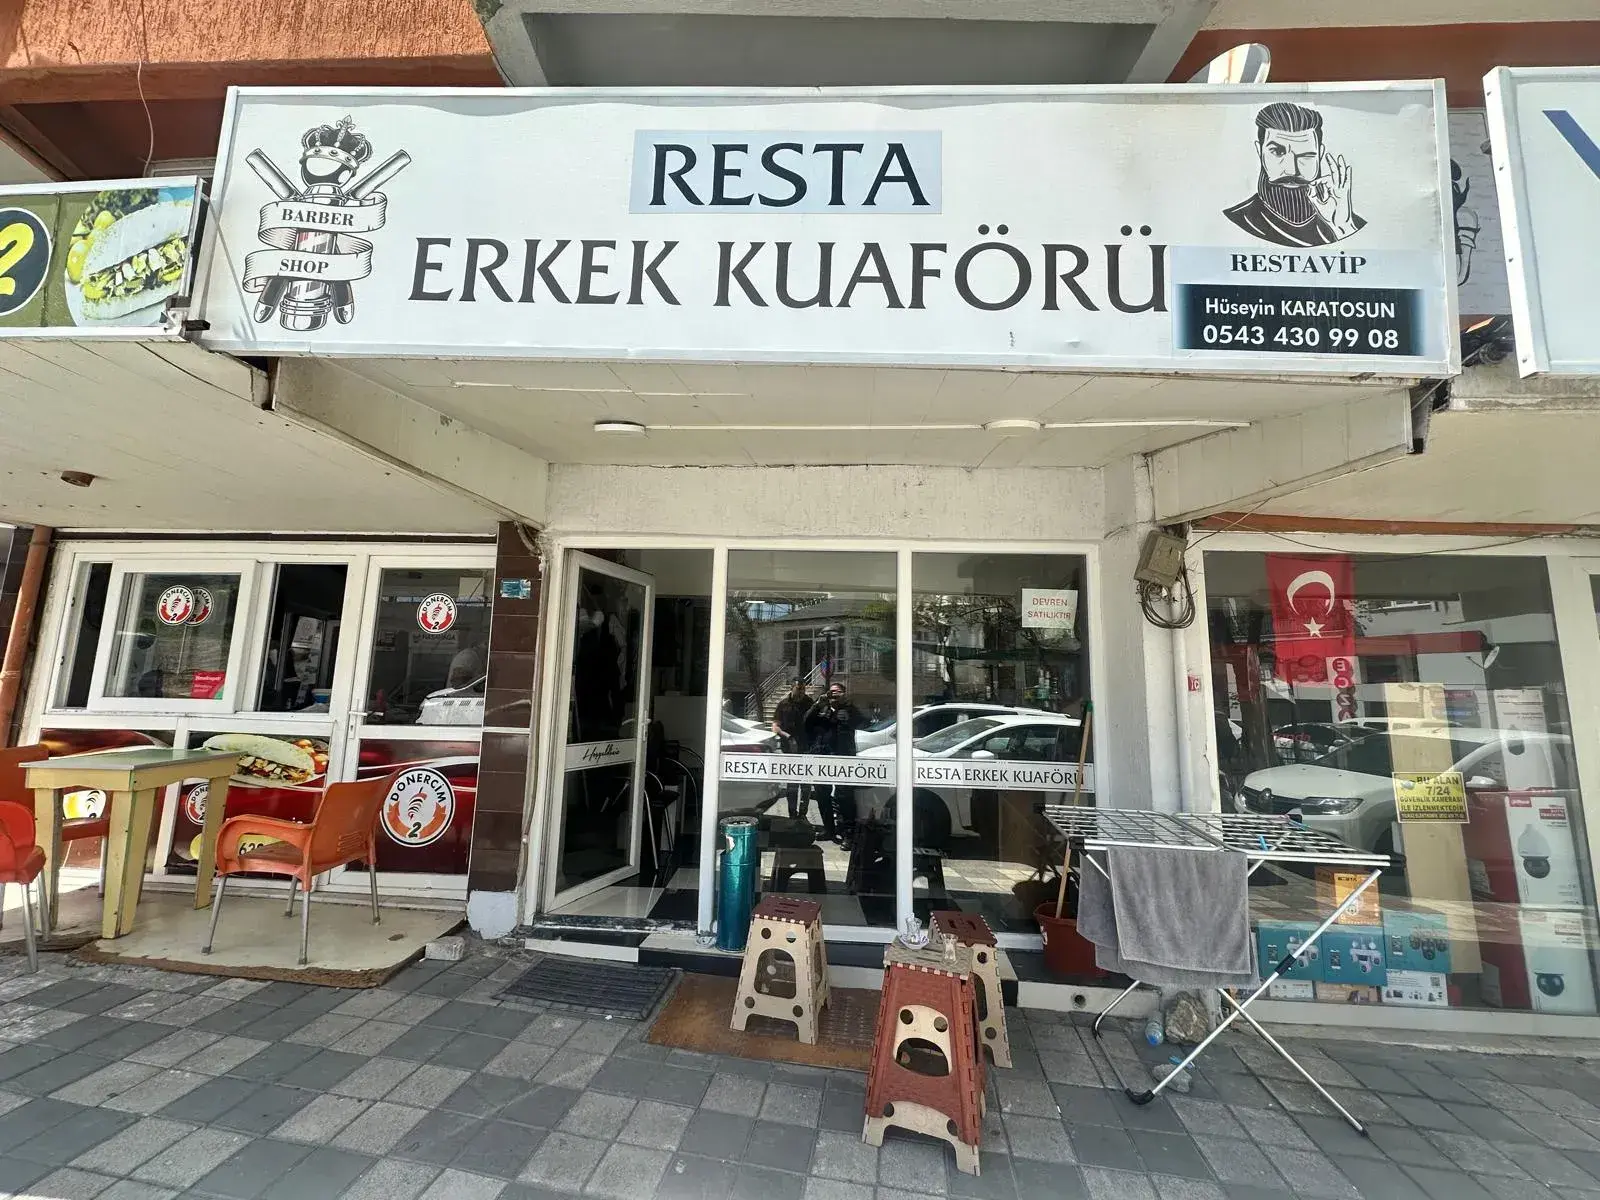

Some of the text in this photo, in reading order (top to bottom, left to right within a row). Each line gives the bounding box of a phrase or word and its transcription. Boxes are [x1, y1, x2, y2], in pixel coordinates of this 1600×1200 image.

[649, 142, 930, 207] RESTA
[281, 207, 354, 227] BARBER
[279, 257, 329, 274] SHOP
[408, 224, 1168, 313] ERKEK KUAFÖRÜ
[1230, 250, 1367, 274] RESTAVİP
[1205, 298, 1395, 318] Hüseyin KARATOSUN
[1203, 325, 1399, 348] 0543 430 99 08
[1032, 597, 1068, 606] DEVREN
[170, 613, 178, 621] 2
[432, 621, 440, 630] 2
[725, 760, 888, 779] RESTA ERKEK KUAFÖRÜ
[917, 766, 961, 780] RESTA
[964, 768, 1009, 782] ERKEK
[390, 773, 447, 803] DÖNERCİM
[1433, 776, 1459, 785] ALAN
[1425, 786, 1451, 795] 7/24
[408, 821, 422, 838] 2
